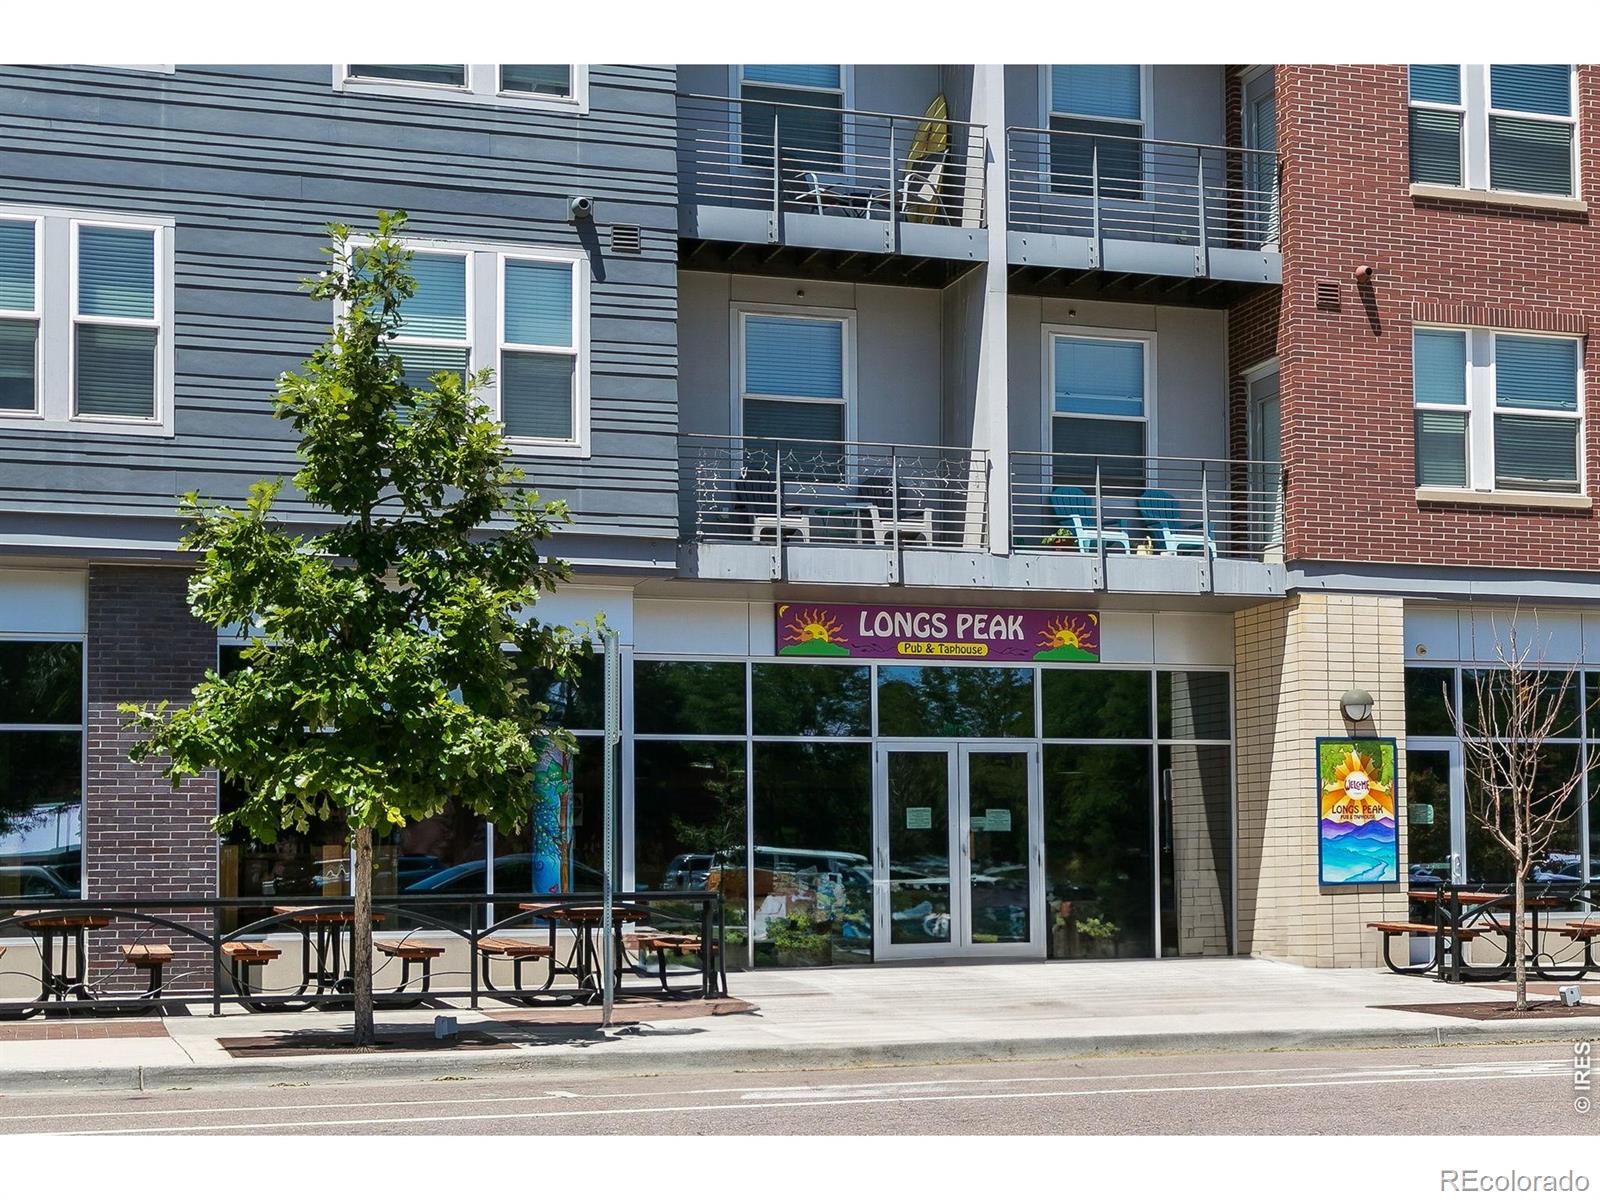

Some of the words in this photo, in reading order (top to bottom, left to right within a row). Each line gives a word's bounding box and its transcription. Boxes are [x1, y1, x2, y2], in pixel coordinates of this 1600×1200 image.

[859, 611, 948, 638] LONGS
[956, 613, 1025, 640] PEAK
[904, 643, 923, 654] Pub
[925, 643, 934, 654] &
[938, 644, 983, 656] Taphouse
[1344, 779, 1370, 791] WELCOME
[1332, 804, 1360, 814] LONGS
[1362, 804, 1384, 814] PEAK
